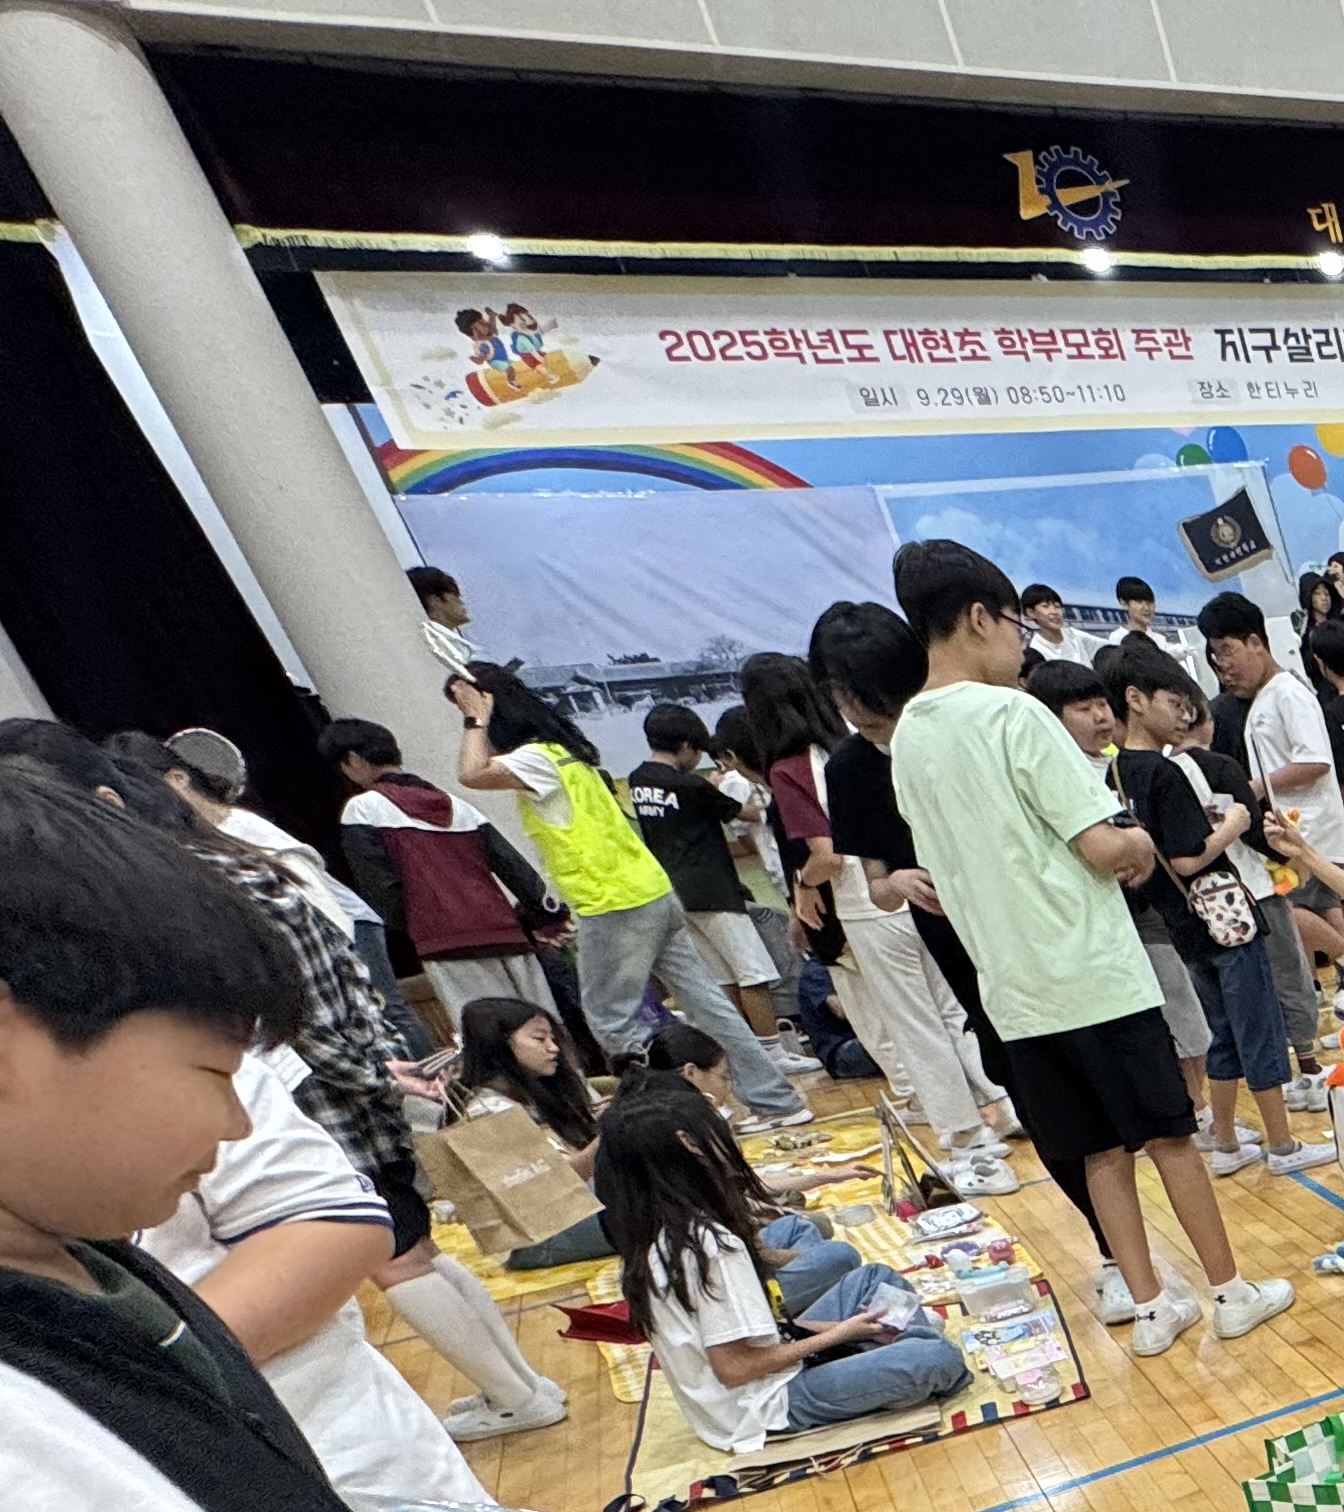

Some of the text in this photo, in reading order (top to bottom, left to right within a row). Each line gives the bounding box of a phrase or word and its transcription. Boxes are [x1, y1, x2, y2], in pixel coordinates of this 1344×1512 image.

[658, 328, 881, 366] 2025학년도
[886, 326, 992, 365] 대현초
[995, 326, 1127, 363] 학부모회
[1131, 327, 1194, 362] 주관
[859, 379, 1320, 409] 일시 9.29(월) 08:50~11:10 장소 한티누리
